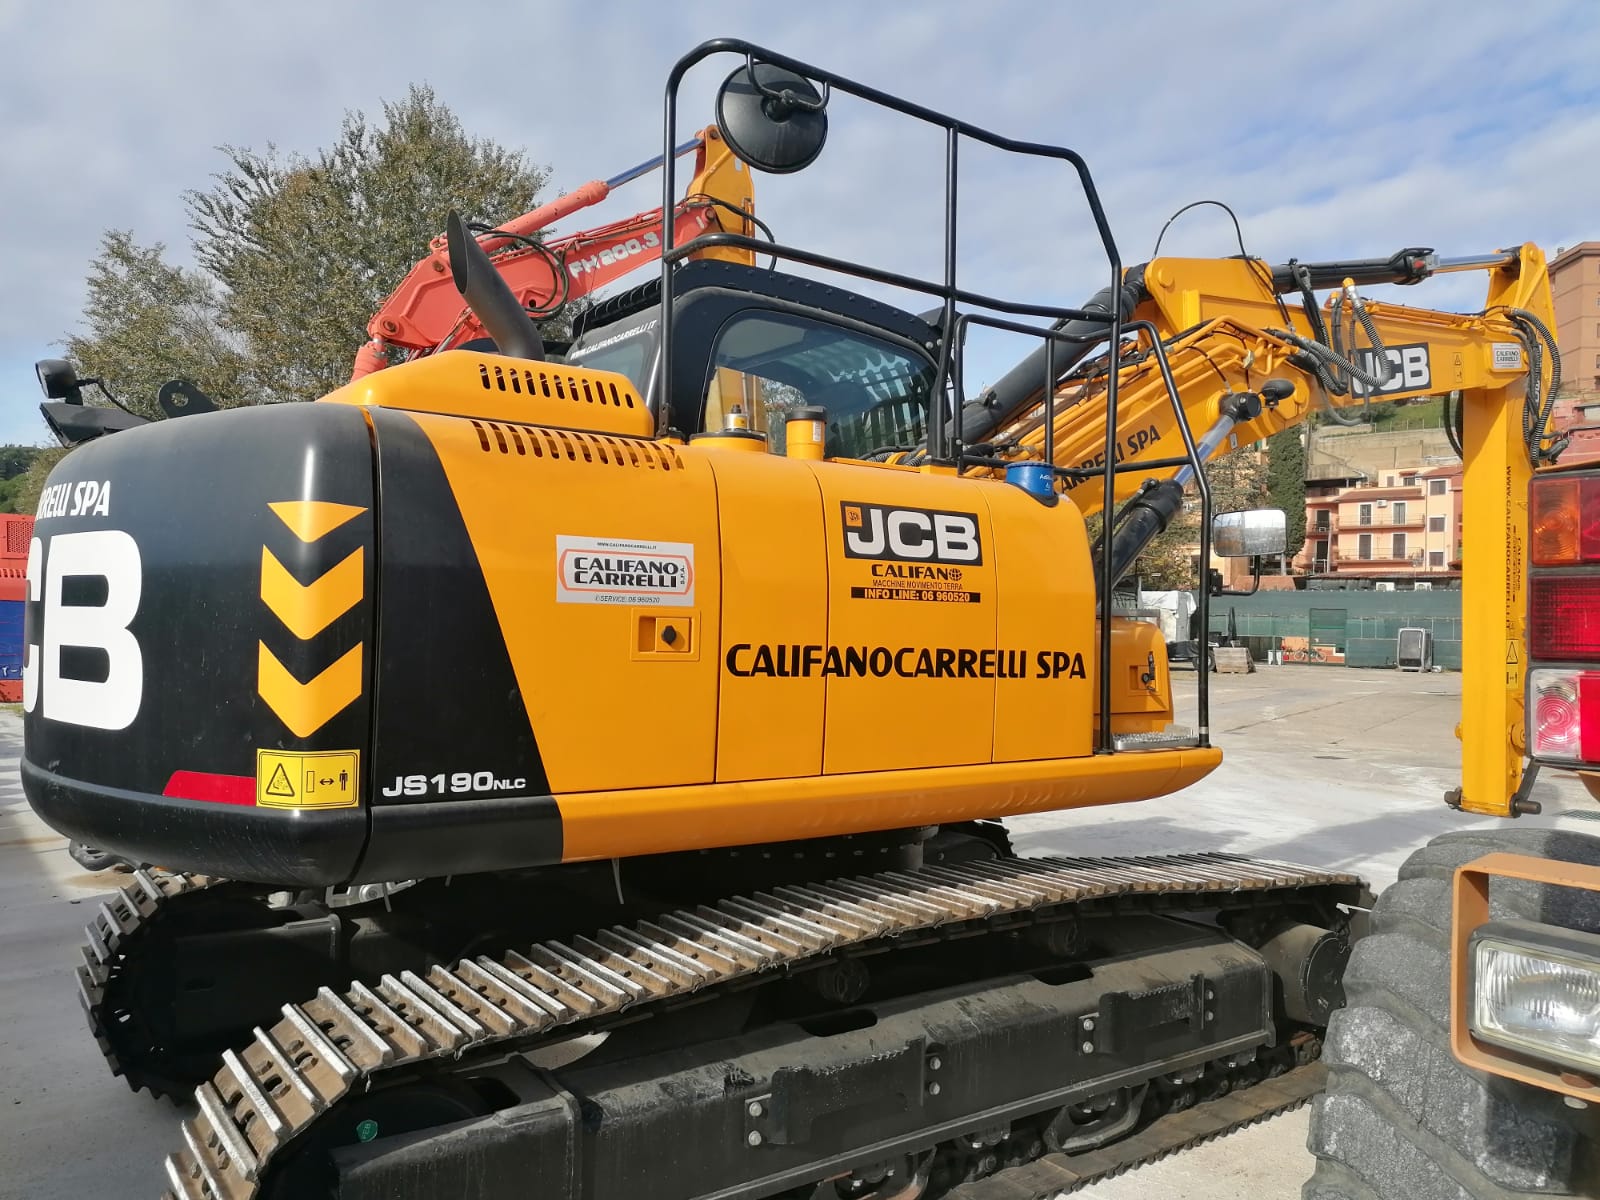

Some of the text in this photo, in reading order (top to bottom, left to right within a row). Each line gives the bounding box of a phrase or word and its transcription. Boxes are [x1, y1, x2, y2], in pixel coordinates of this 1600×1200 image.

[568, 231, 660, 279] FH200.3
[1352, 347, 1430, 394] JCB
[1127, 424, 1161, 456] SPA
[69, 480, 111, 516] SPA
[846, 508, 979, 560] JCB
[574, 557, 679, 575] CALIFANO
[574, 571, 677, 588] CARRELLI
[864, 588, 971, 603] INFO LINE: 06 960520
[872, 578, 963, 591] MACCHINE MOVIMENTO TERRA
[726, 643, 1087, 680] CALIFANOCARRELLI SPA
